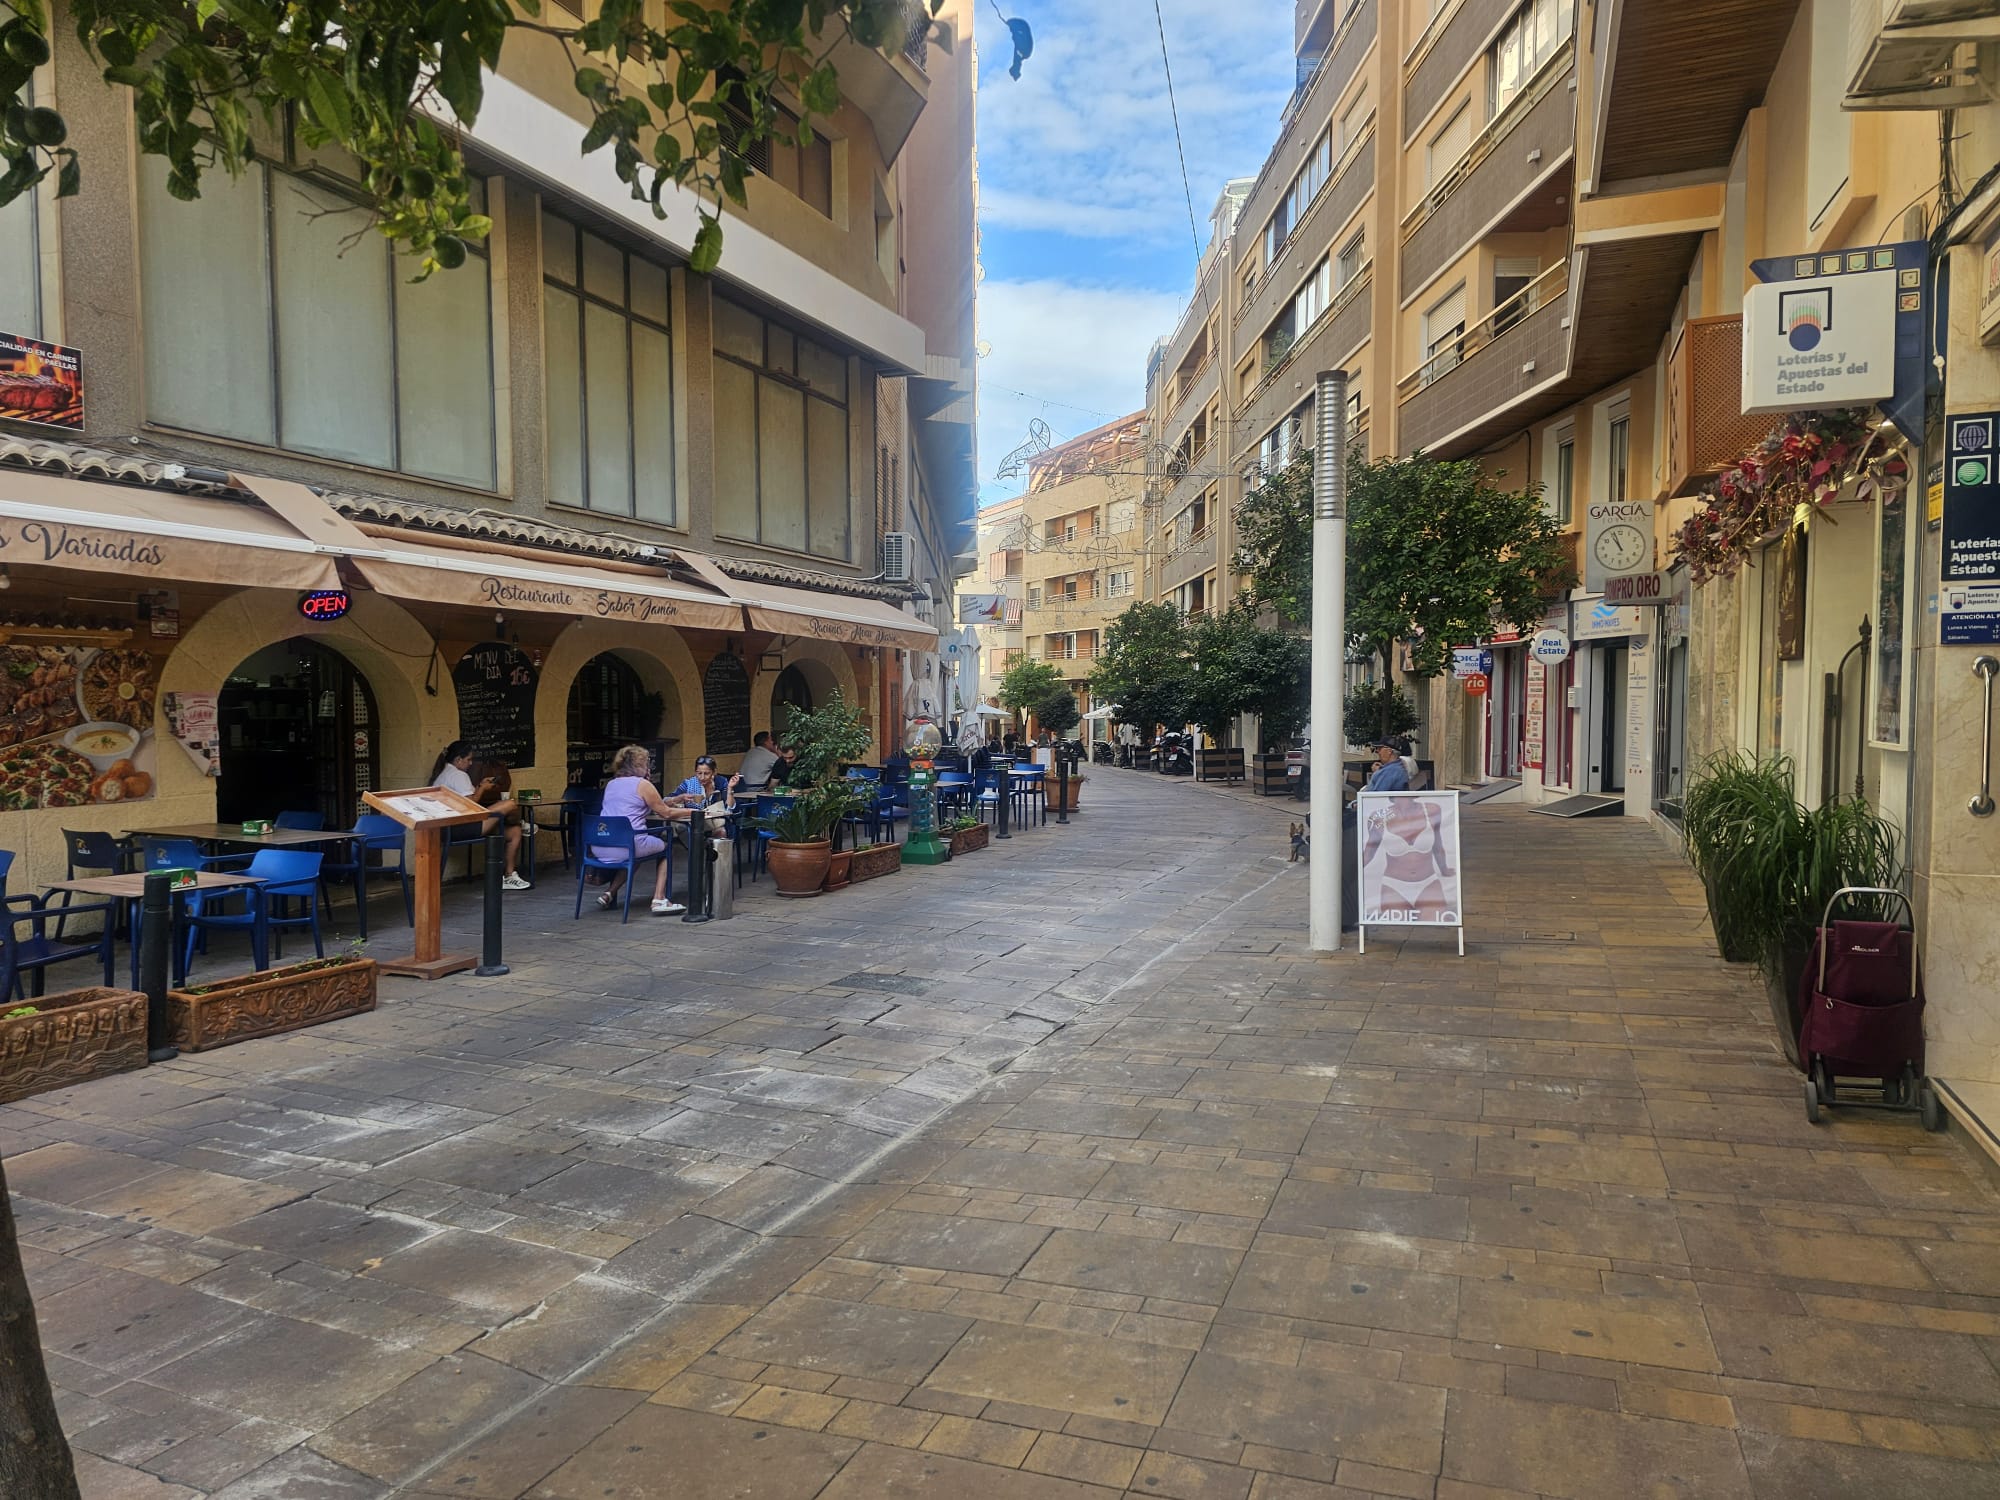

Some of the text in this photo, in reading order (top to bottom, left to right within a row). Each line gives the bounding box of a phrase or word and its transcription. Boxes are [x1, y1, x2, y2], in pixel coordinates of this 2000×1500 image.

[35, 349, 46, 357] EN
[46, 351, 77, 364] CARNES
[1777, 351, 1846, 366] Loterías y
[45, 358, 78, 371] PAELLAS
[1777, 362, 1868, 382] Apuestas del
[1776, 380, 1825, 394] Estado
[1590, 502, 1652, 520] GARCÍA
[21, 522, 166, 565] Variadas
[1949, 563, 1996, 575] Estado
[1636, 574, 1661, 598] ORO
[481, 577, 574, 606] Restaurante
[596, 590, 638, 617] Sabor
[303, 596, 347, 614] OPEN
[1542, 639, 1562, 647] Real
[1537, 647, 1566, 655] Estate
[1467, 676, 1485, 688] ria
